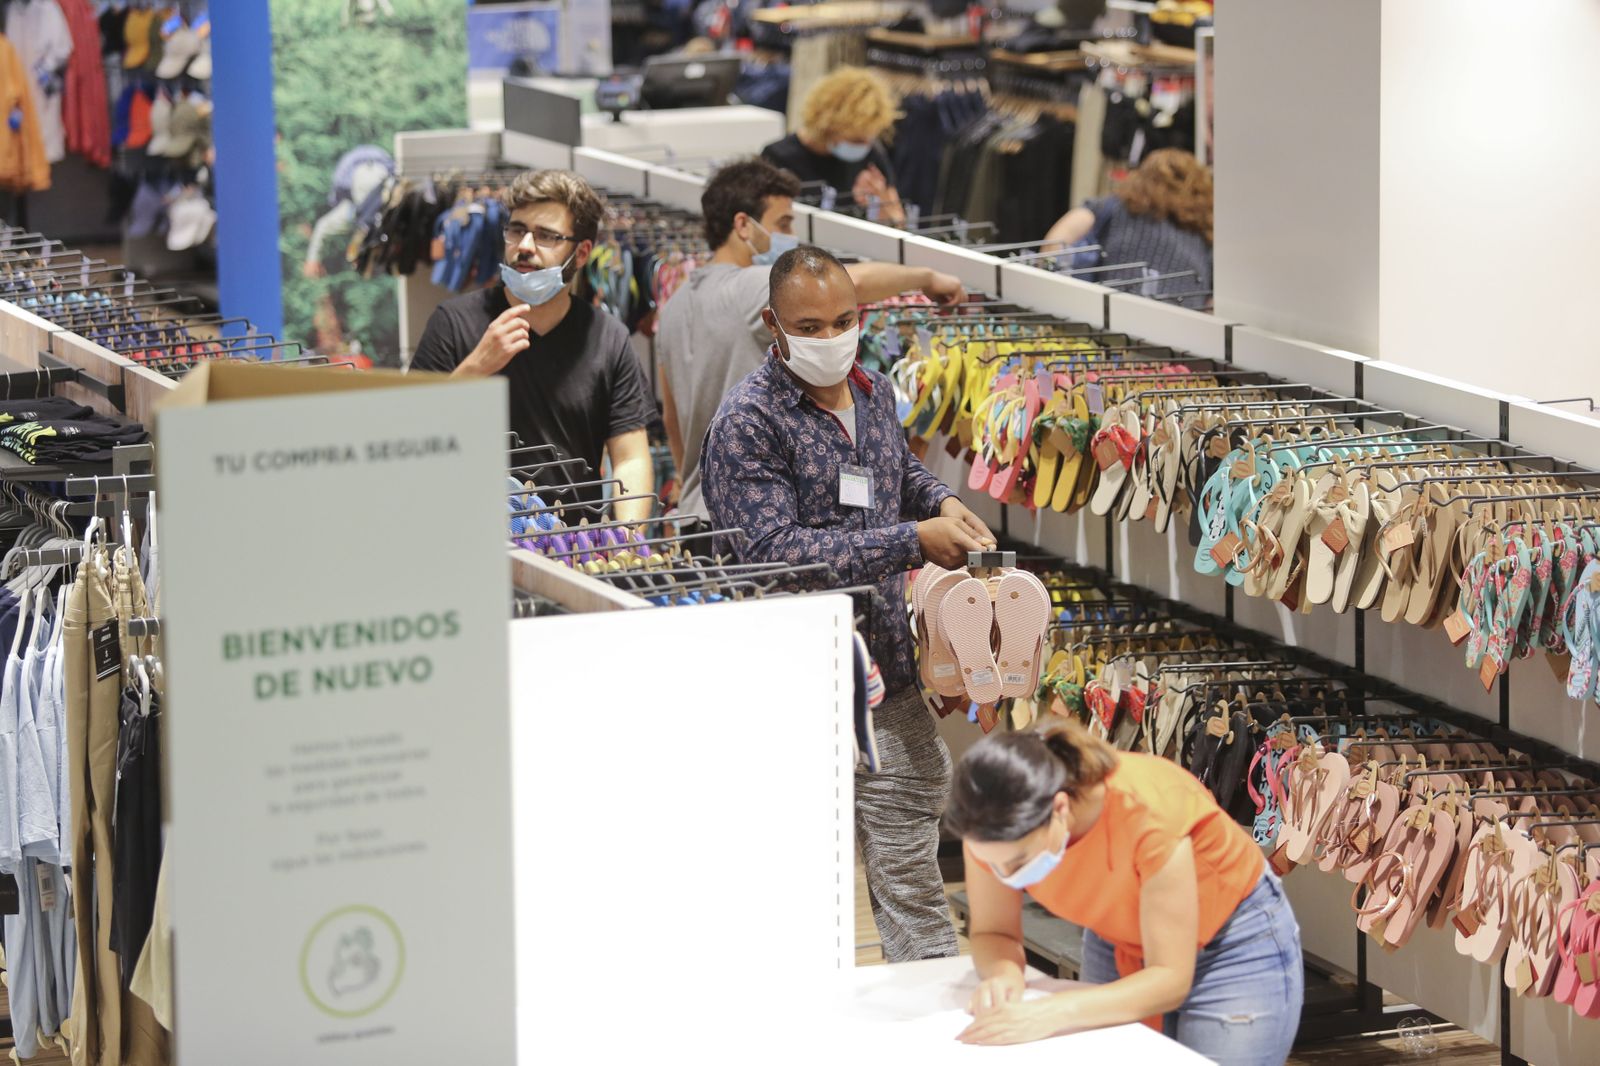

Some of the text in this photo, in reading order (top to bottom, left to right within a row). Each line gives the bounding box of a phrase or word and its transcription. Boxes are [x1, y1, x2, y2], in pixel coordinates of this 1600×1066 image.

[213, 436, 460, 476] TU COMPRA SEGURA
[222, 610, 460, 661] BIENVENIDOS
[254, 655, 433, 700] DE NUEVO
